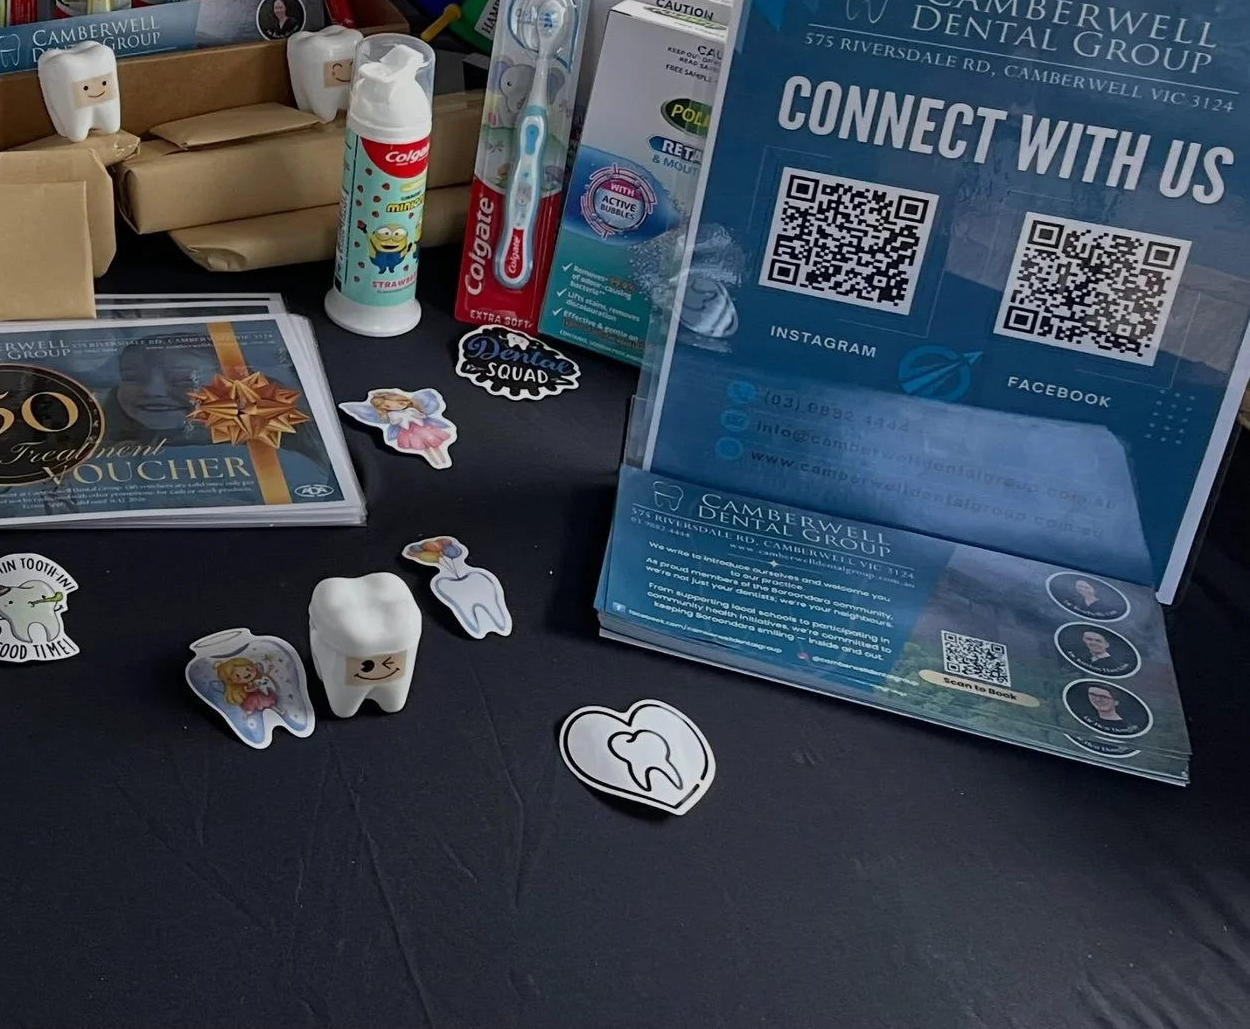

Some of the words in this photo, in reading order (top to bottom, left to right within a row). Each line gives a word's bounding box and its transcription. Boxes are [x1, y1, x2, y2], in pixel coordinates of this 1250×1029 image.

[32, 15, 161, 48] CAMBERWELL
[910, 3, 1058, 53] DENTAL
[1072, 29, 1213, 74] GROUP
[804, 32, 834, 49] 575
[839, 36, 958, 70] RIVERSDALE
[962, 57, 997, 78] RD,
[1004, 64, 1143, 100] CAMBERWELL
[1151, 87, 1186, 106] VIC
[1190, 94, 1236, 113] 3124
[385, 142, 430, 164] Colga
[777, 75, 1008, 165] CONNECT
[1017, 114, 1151, 191] WITH
[1158, 142, 1236, 205] US
[601, 193, 637, 212] ACTIVE
[610, 182, 635, 197] WITH
[600, 203, 636, 222] BUBBLES
[464, 196, 496, 296] Colgate
[508, 235, 522, 274] Colgate
[469, 309, 502, 324] EXTRA
[504, 315, 531, 329] SOFT
[6, 348, 72, 361] GROUP
[464, 334, 572, 374] Dental
[770, 325, 878, 359] INSTAGRAM
[486, 362, 550, 384] SQUAD
[1007, 375, 1113, 409] FACEBOOK
[43, 456, 252, 487] VOUCHER
[698, 505, 793, 538] DENTAL
[802, 528, 892, 558] GROUP
[702, 493, 892, 546] CAMBERWELL
[655, 514, 733, 540] RIVERSDALE
[763, 539, 856, 566] CAMBERWELL
[649, 541, 665, 551] We
[666, 546, 690, 557] write
[691, 552, 701, 560] to
[703, 555, 750, 571] introduce
[752, 566, 800, 582] ourselves
[801, 577, 822, 587] and
[823, 582, 870, 598] welcome
[943, 676, 972, 691] Scan
[975, 684, 987, 694] to
[987, 686, 1019, 702] Book
